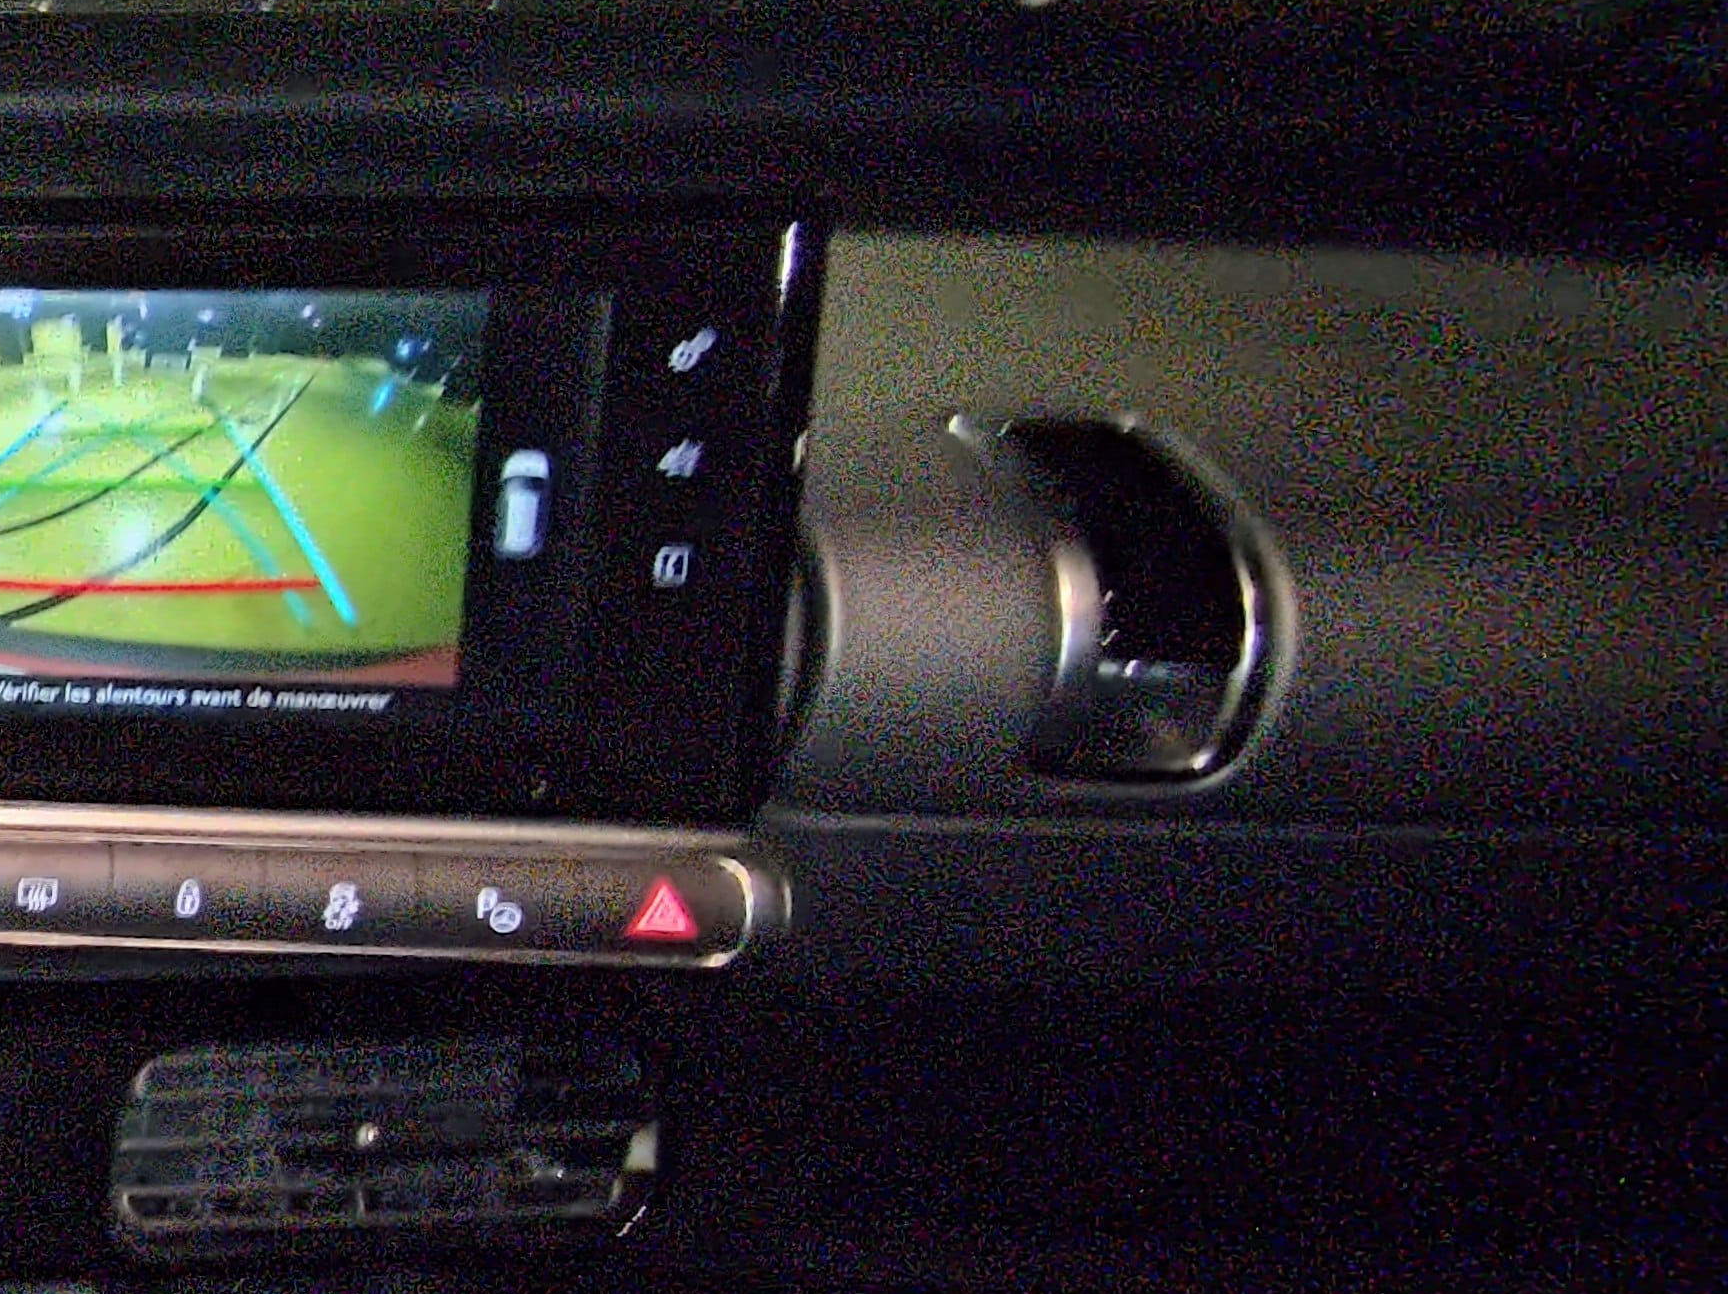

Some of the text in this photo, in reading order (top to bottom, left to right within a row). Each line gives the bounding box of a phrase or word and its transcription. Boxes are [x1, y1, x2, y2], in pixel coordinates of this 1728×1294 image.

[65, 682, 91, 704] les
[95, 683, 186, 706] alentours
[191, 688, 242, 707] avant
[246, 686, 272, 708] de
